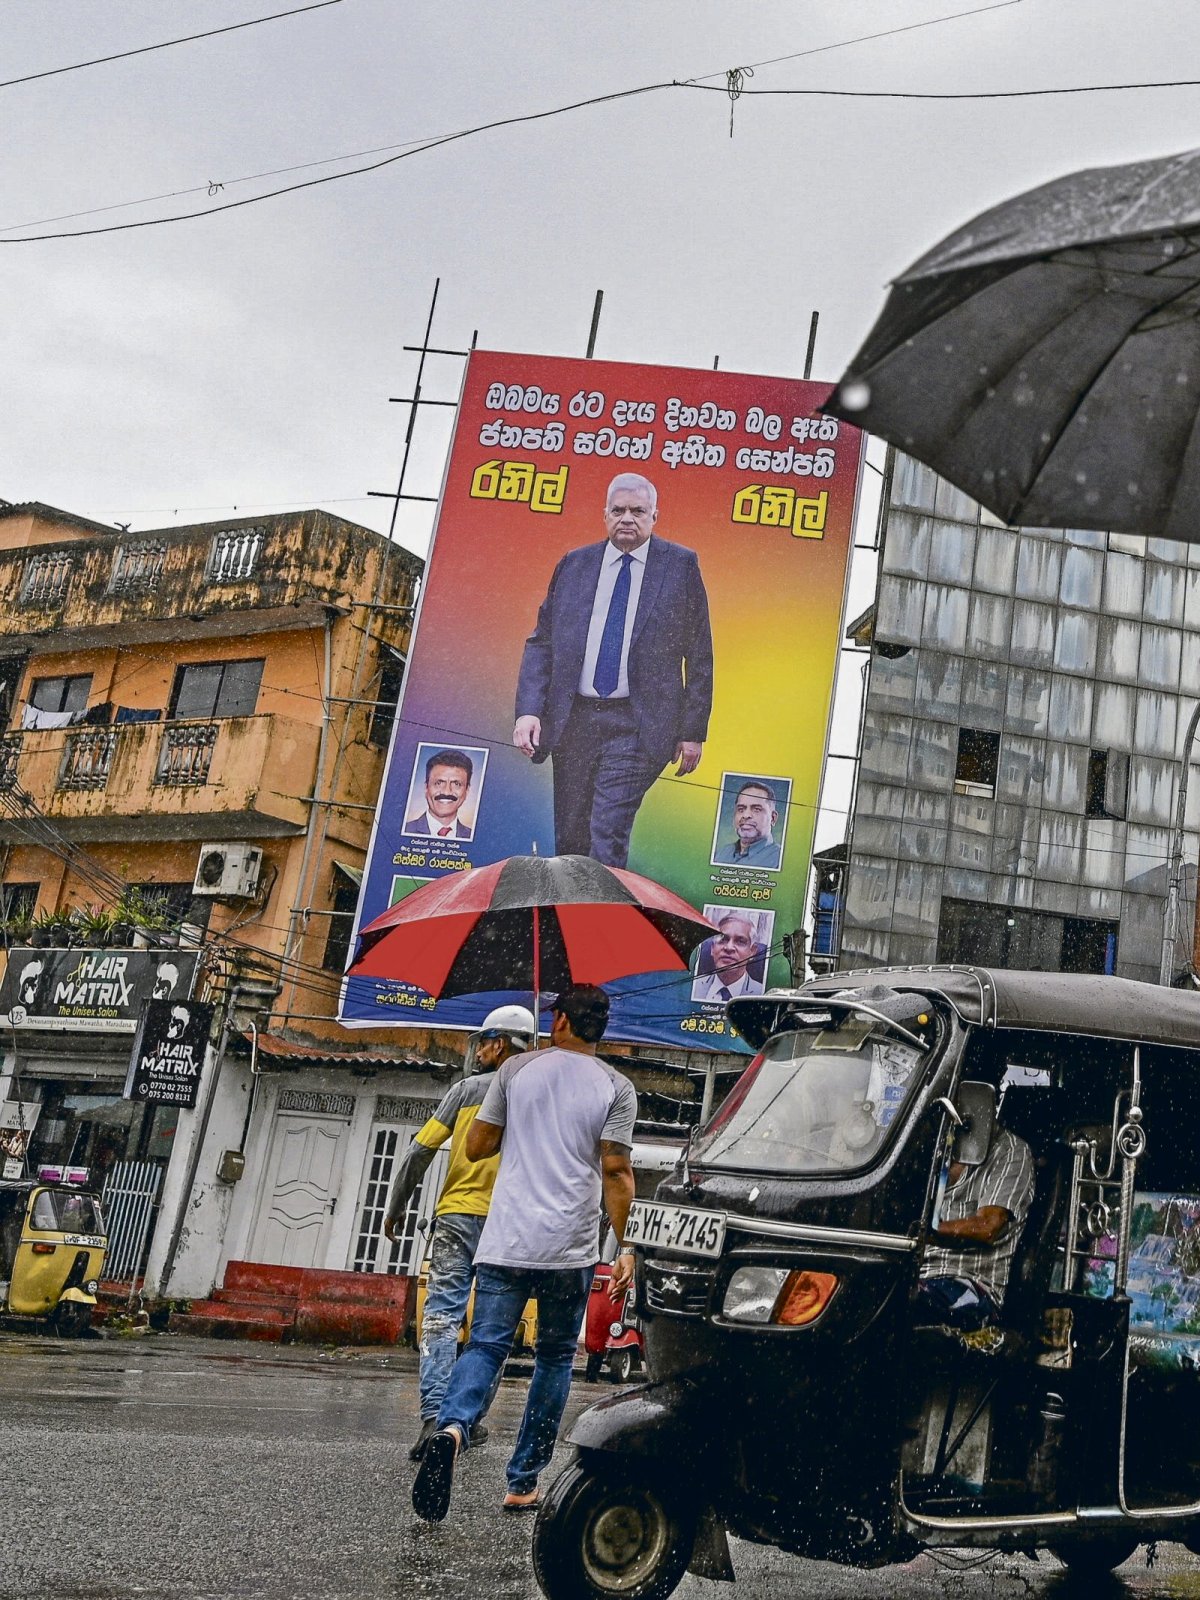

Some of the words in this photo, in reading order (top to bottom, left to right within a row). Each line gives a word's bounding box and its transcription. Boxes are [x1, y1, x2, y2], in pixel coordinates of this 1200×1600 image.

[568, 390, 605, 419] රට
[612, 397, 656, 428] දැය
[663, 397, 737, 432] දිනවන
[745, 406, 782, 441] බල
[479, 418, 565, 452] ජනපති
[469, 459, 570, 514] රනිල්
[731, 483, 830, 540] රනිල්
[81, 956, 129, 981] HAIR
[53, 980, 135, 1006] MATRIX
[58, 1005, 70, 1016] The
[71, 1006, 96, 1017] Unisex
[97, 1007, 118, 1017] Salon
[159, 1042, 193, 1058] HAIR
[140, 1056, 199, 1076] MATRIX
